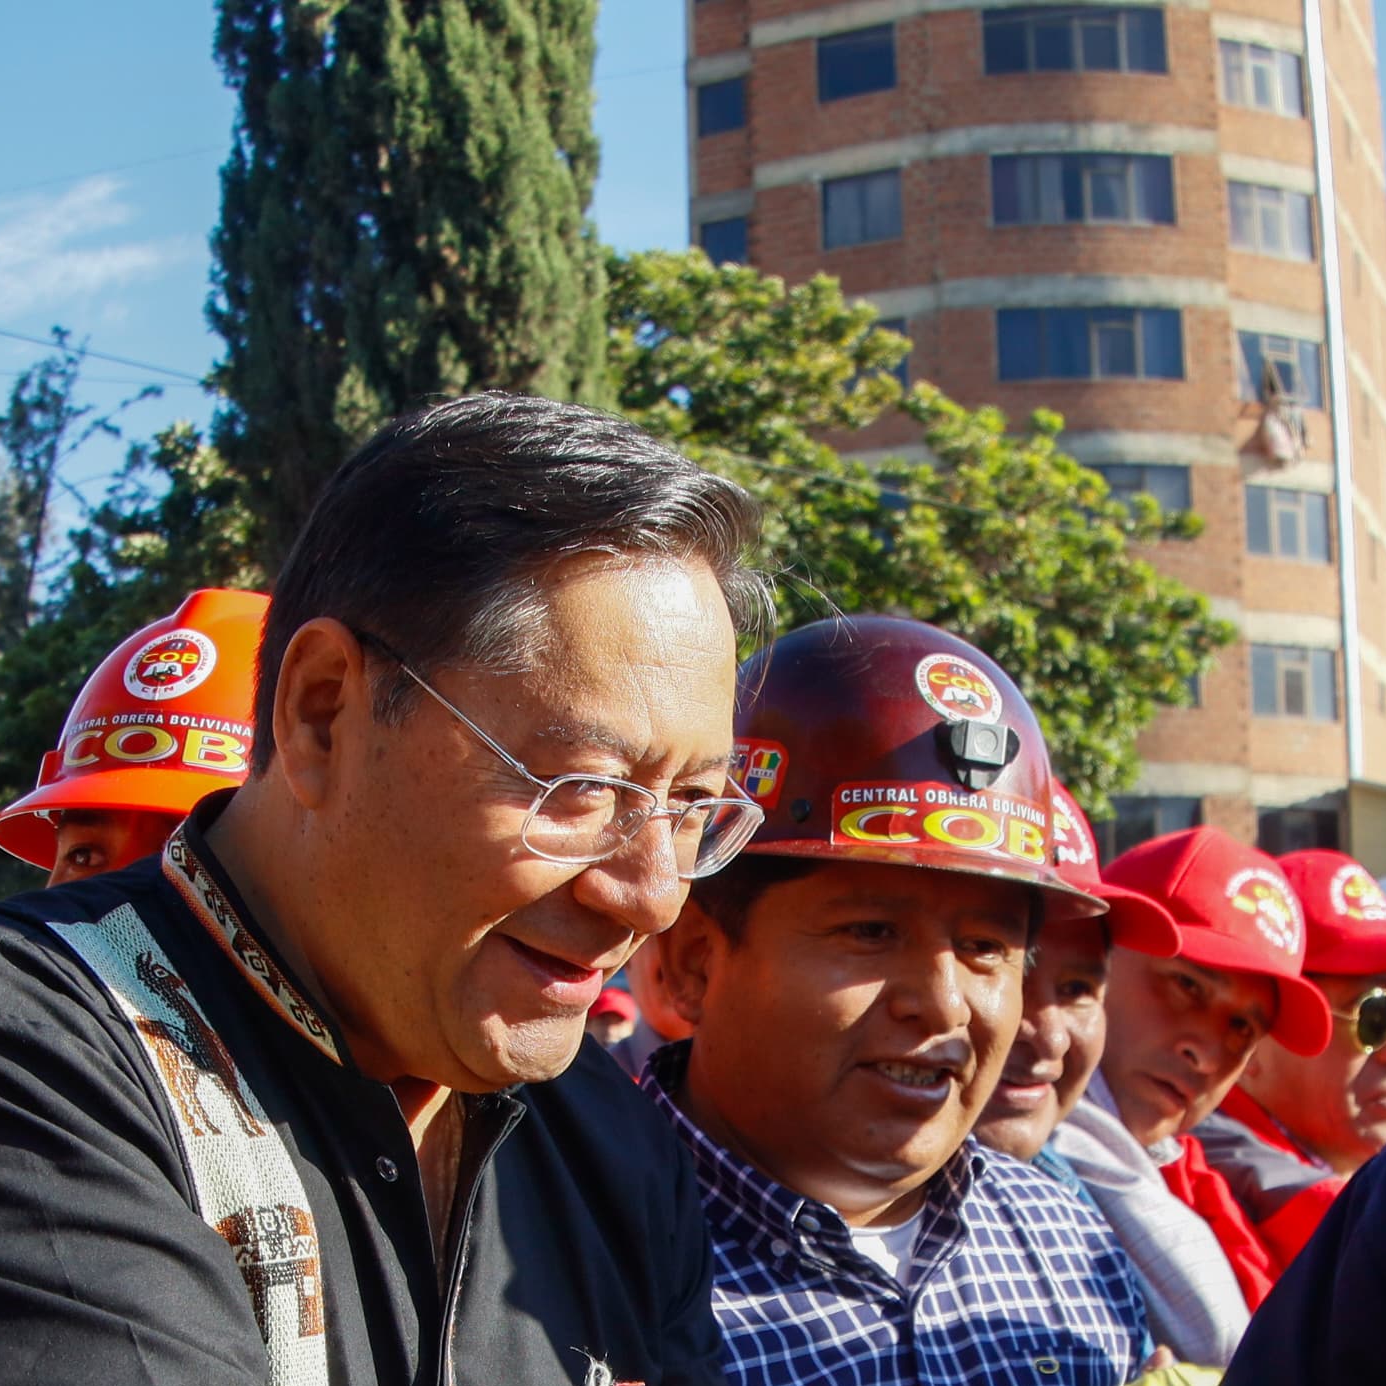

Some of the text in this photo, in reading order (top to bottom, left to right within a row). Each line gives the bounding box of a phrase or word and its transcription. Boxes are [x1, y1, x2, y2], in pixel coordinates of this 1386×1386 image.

[142, 652, 198, 663] COB
[929, 672, 990, 697] COB
[68, 713, 253, 738] CENTRAL OBRERA BOLIVIANA
[63, 725, 248, 772] COB
[841, 787, 919, 804] CENTRAL
[925, 789, 988, 809] OBRERA
[839, 805, 1047, 865] COB
